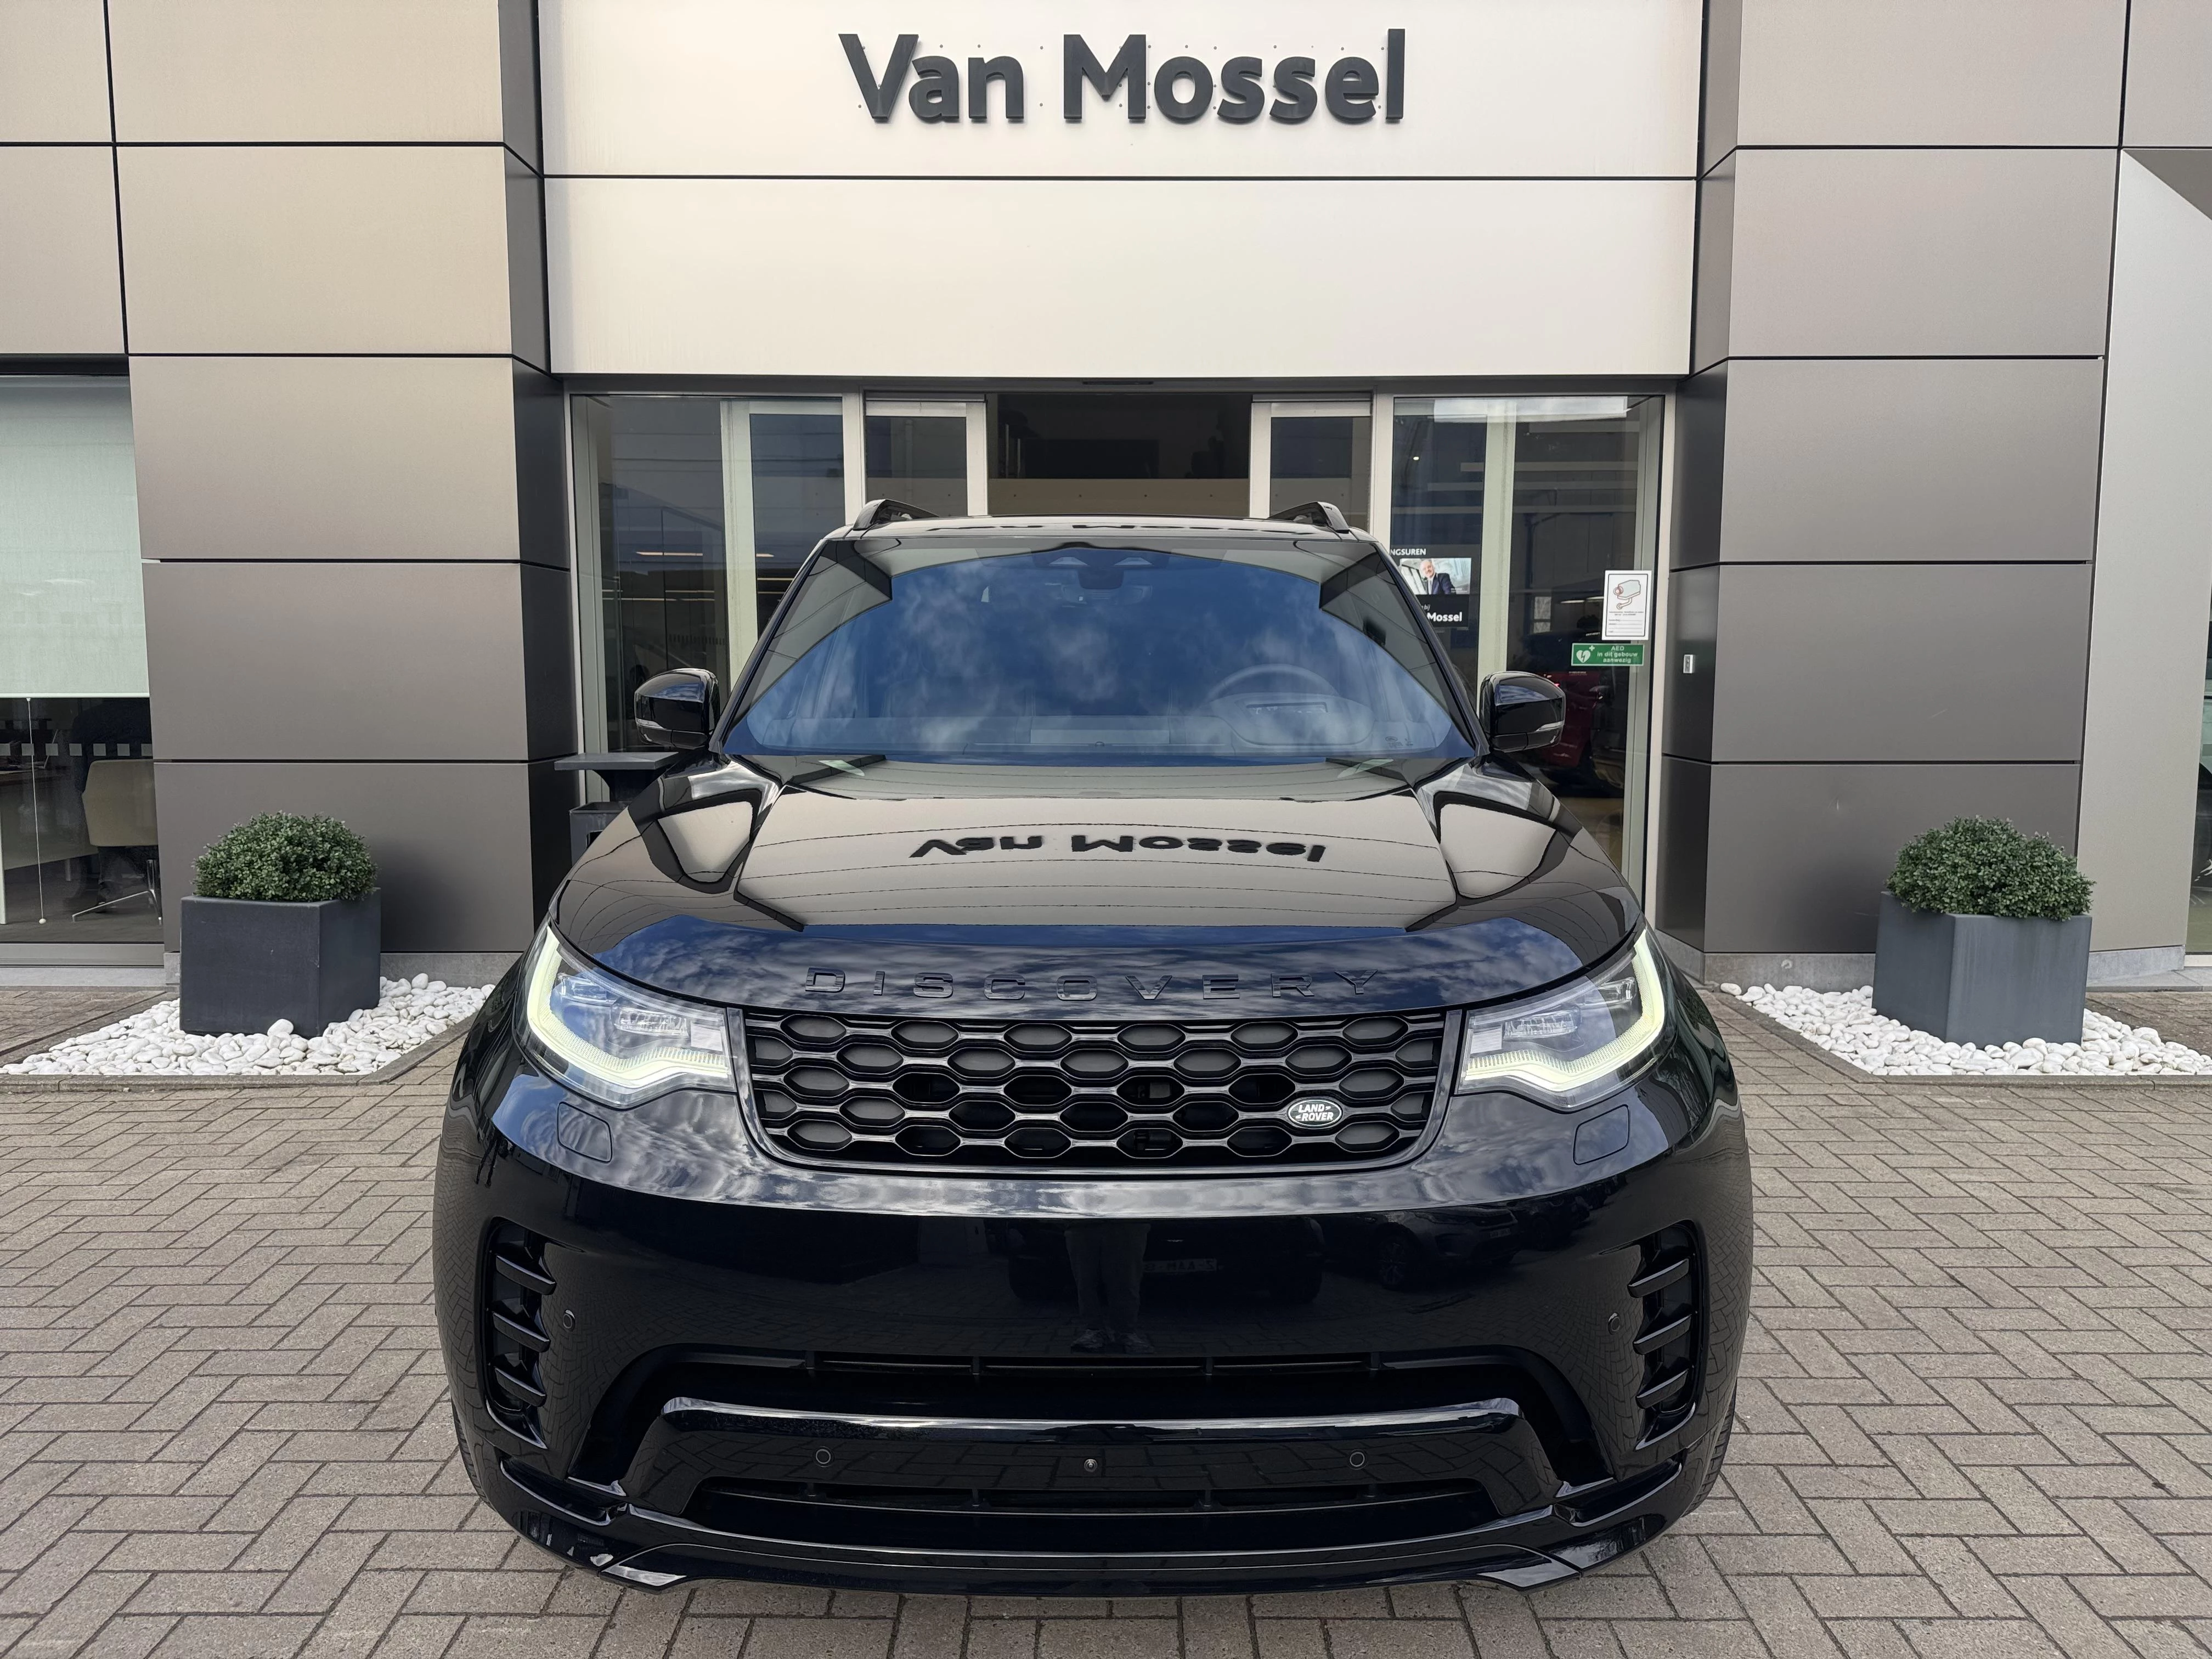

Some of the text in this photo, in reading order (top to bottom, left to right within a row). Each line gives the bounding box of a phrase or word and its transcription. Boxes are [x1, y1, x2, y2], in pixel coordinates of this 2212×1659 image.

[838, 28, 1406, 125] Van Mossel
[1427, 612, 1462, 622] Mossel
[805, 967, 1378, 1000] DISCOVERY
[1298, 1104, 1325, 1113] LAND
[1301, 1111, 1334, 1121] ROVER
